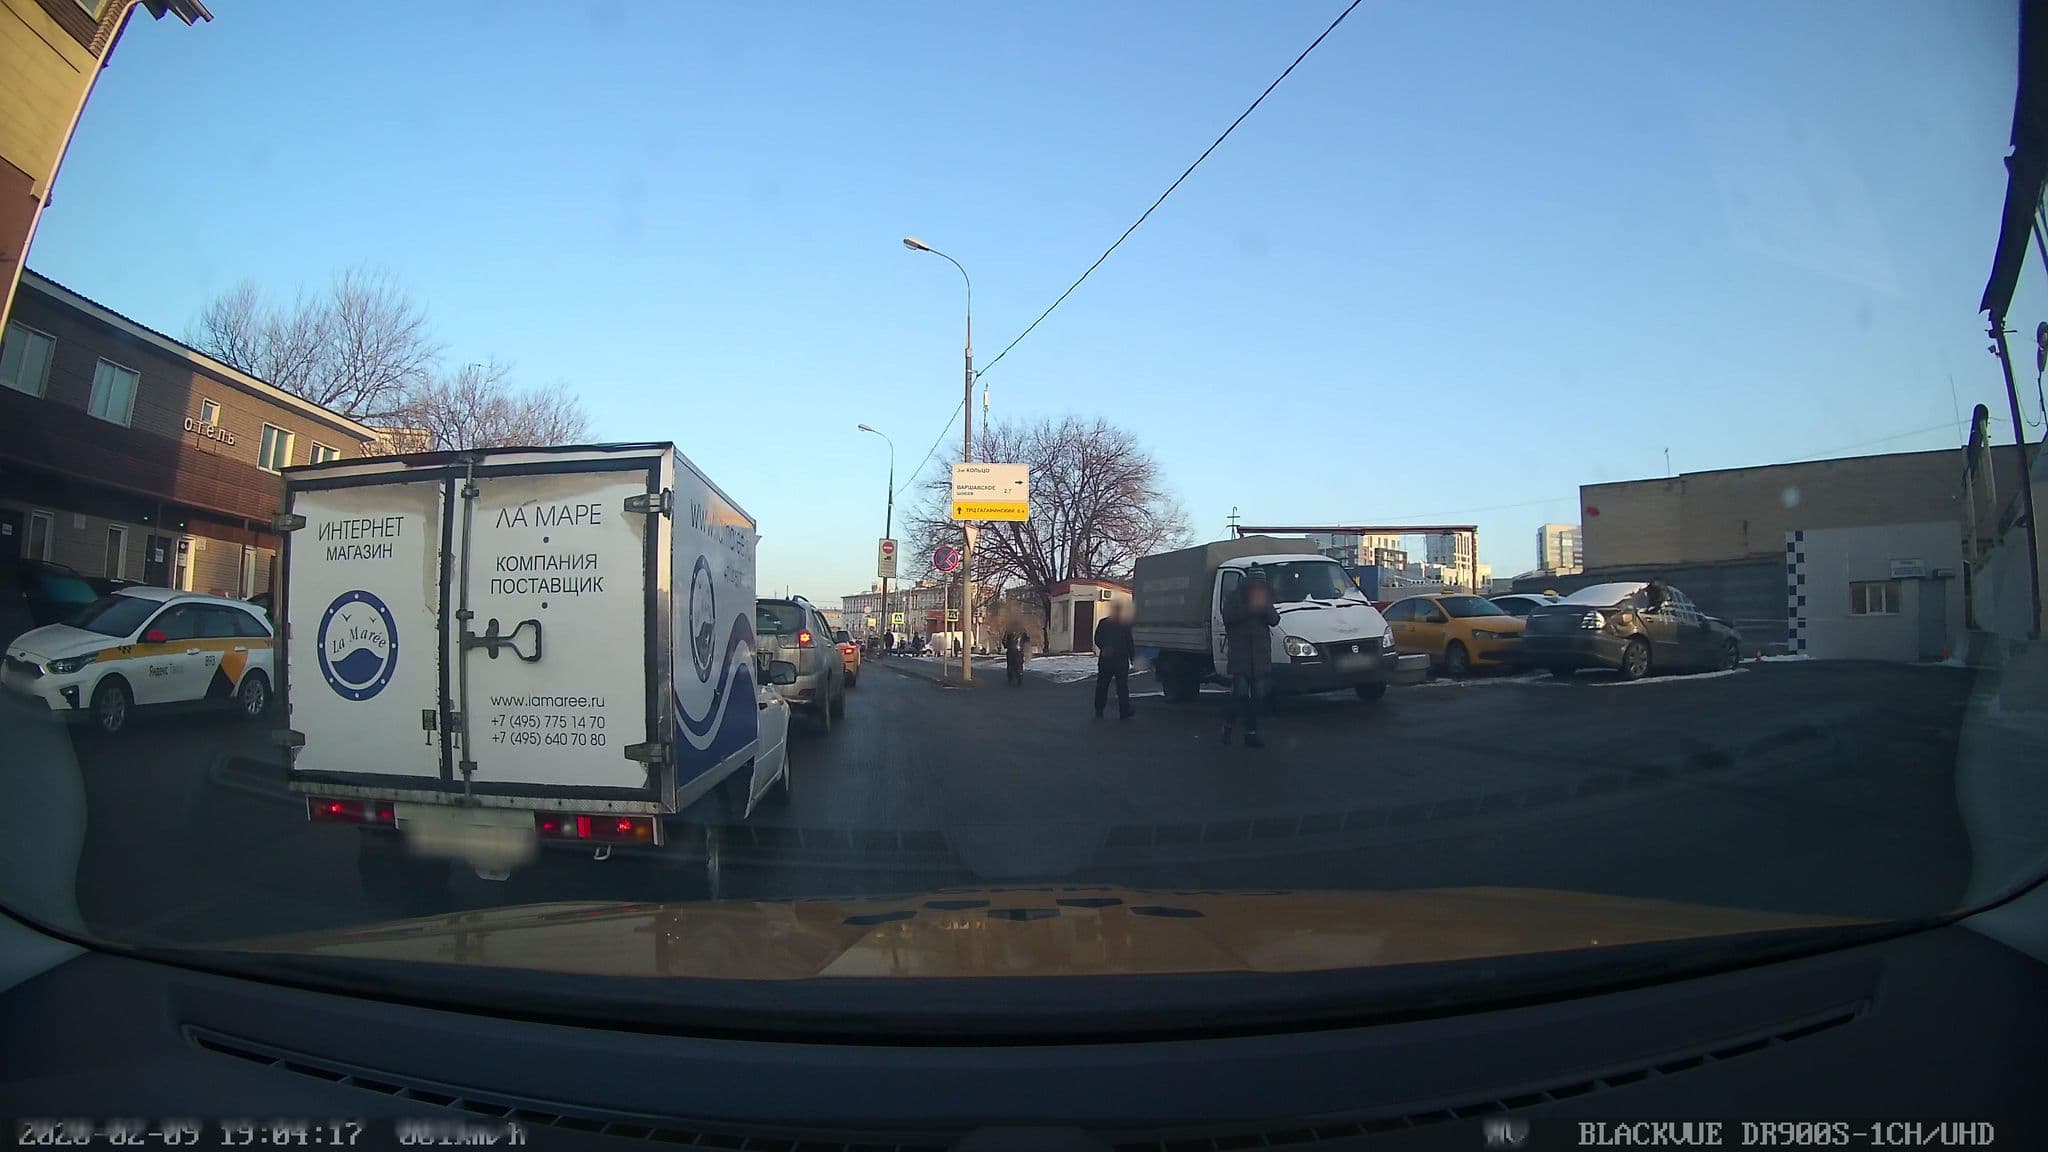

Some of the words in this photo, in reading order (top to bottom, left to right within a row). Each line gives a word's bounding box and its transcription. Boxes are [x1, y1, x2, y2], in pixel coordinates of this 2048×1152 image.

[496, 507, 527, 529] ЛА
[535, 503, 602, 527] МАРЕ
[318, 516, 404, 540] ИНТЕРНЕТ
[326, 543, 393, 561] МАГАЗИН
[496, 554, 598, 572] КОМПАНИЯ
[491, 577, 604, 596] ПОСТАВЩИК
[332, 638, 345, 653] La
[349, 626, 387, 648] Marée
[491, 715, 506, 727] +7
[509, 715, 541, 729] (495)
[544, 716, 567, 728] 775
[572, 716, 586, 728] 14
[590, 716, 605, 729] 70
[491, 731, 506, 744] +7
[510, 732, 541, 746] (495)
[545, 733, 567, 746] 640
[571, 733, 587, 746] 70
[590, 733, 606, 746] 80
